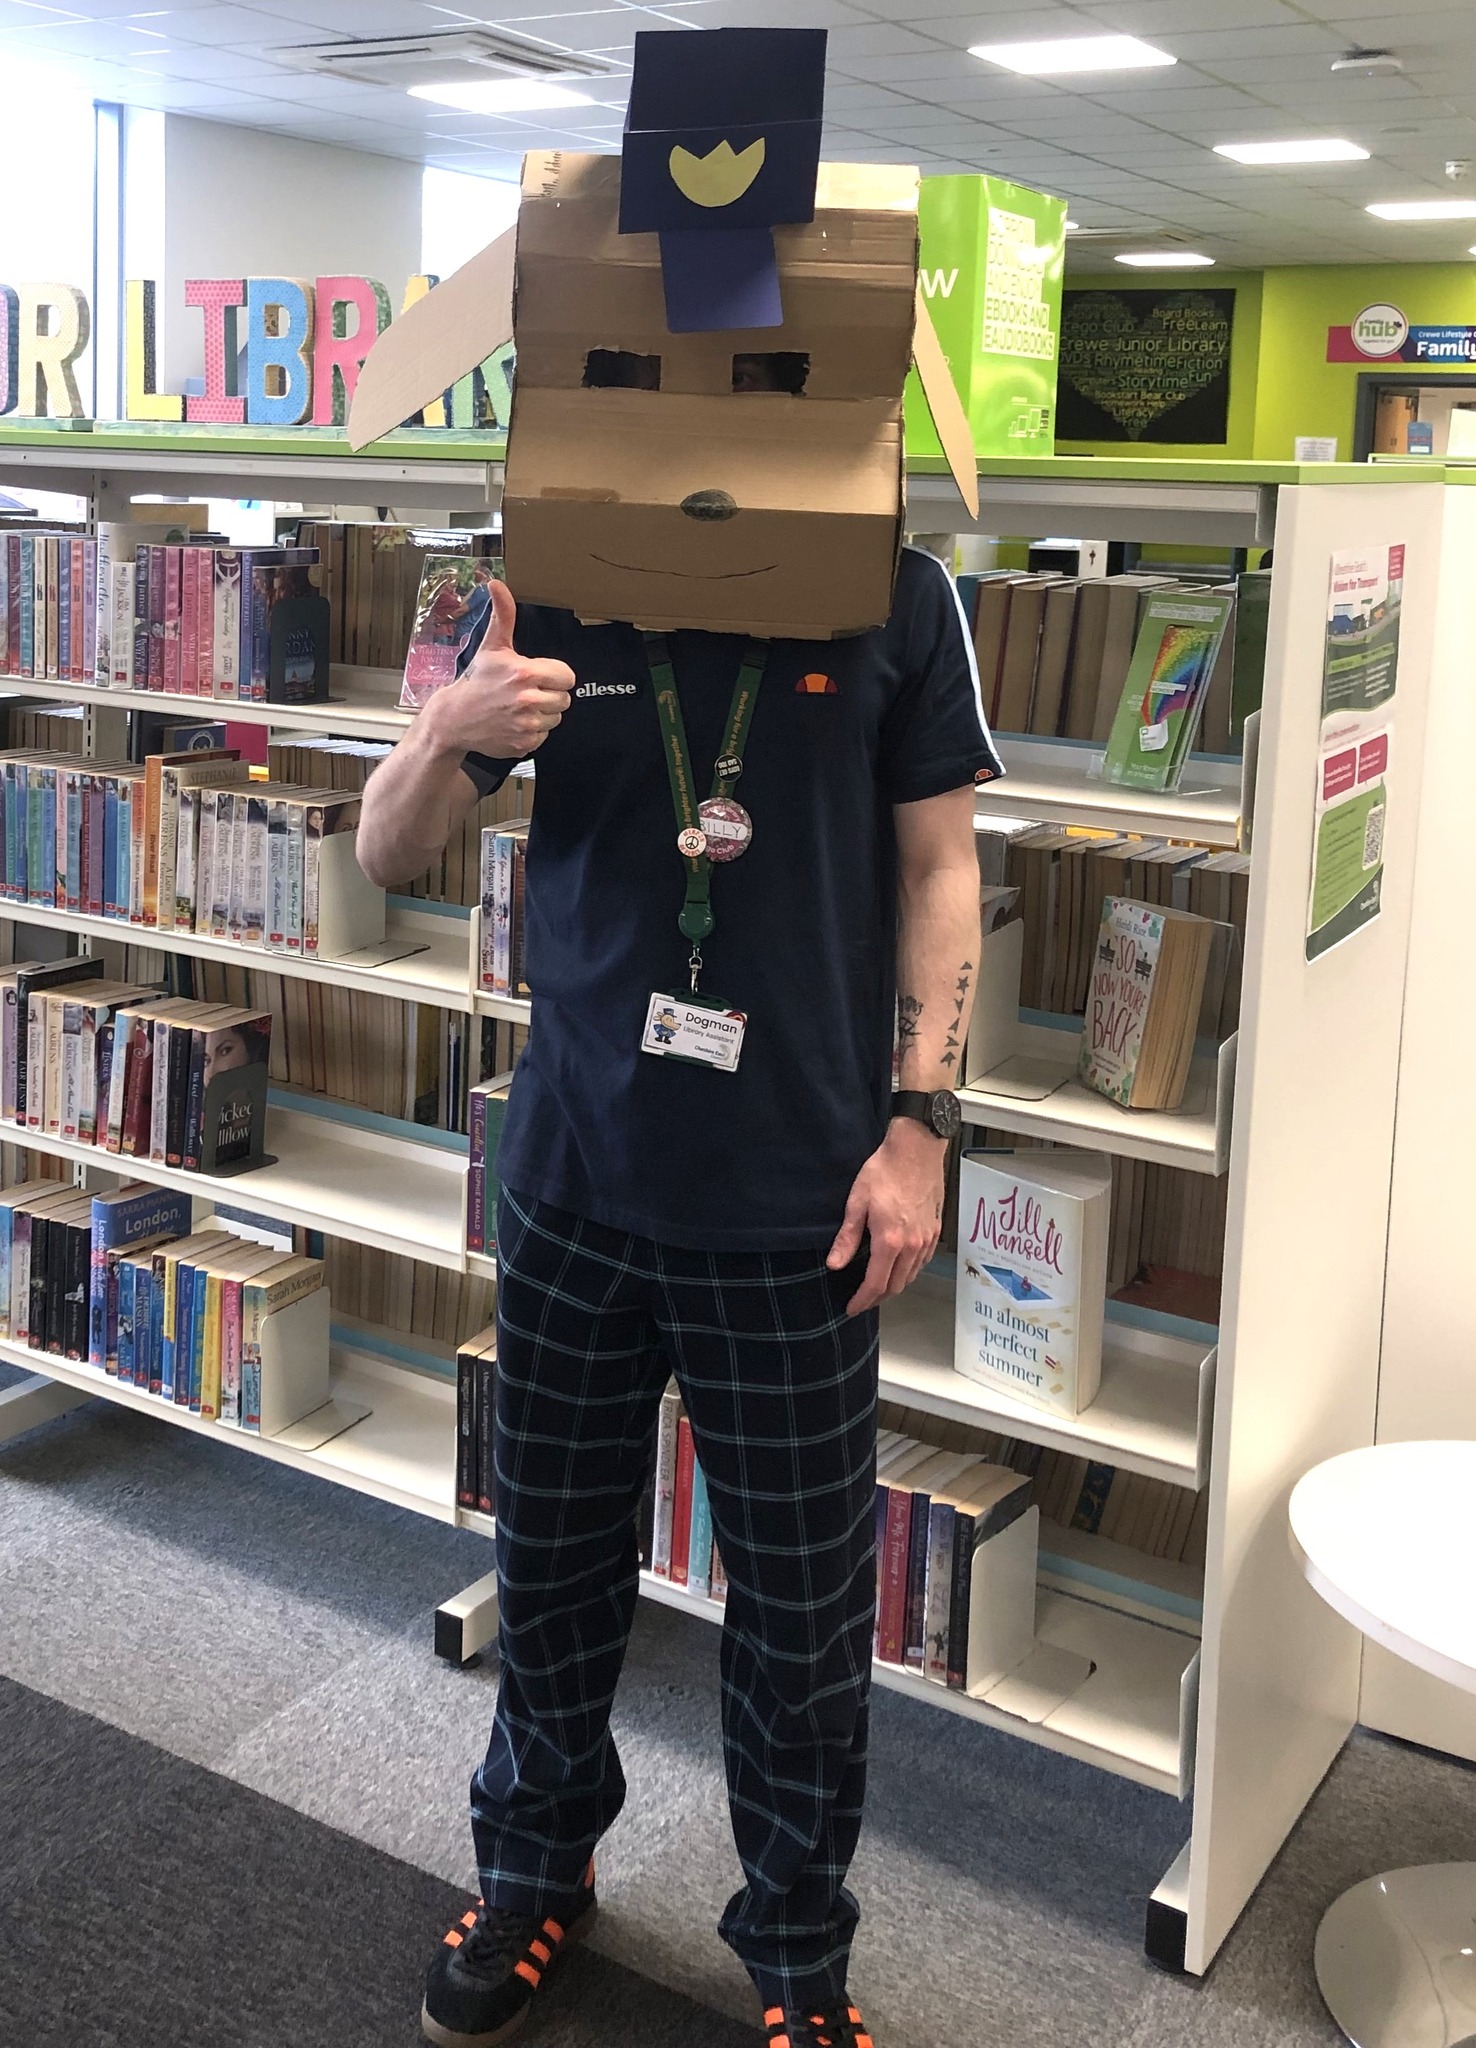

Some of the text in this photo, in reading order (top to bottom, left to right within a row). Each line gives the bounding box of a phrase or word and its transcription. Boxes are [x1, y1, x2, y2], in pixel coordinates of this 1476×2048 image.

[986, 297, 1028, 326] EBOOKS
[1103, 319, 1135, 333] Club
[1152, 308, 1215, 318] Board Books
[1162, 318, 1195, 331] Free
[1195, 319, 1228, 331] Learn
[984, 325, 1054, 357] EAUDIOBOOKS
[1059, 336, 1227, 355] Crewe Junior Library
[1358, 321, 1399, 338] hub
[1441, 330, 1473, 339] Lifestyle
[1095, 352, 1177, 369] Rhymetime
[1176, 356, 1223, 370] Fiction
[1188, 370, 1212, 383] Fun
[1118, 373, 1189, 390] Storytime
[1140, 390, 1163, 400] Bear
[1164, 390, 1186, 401] Club
[1112, 407, 1154, 420] Literacy
[243, 594, 251, 627] JEFFRIES
[575, 682, 638, 698] ellesse
[670, 734, 683, 766] together
[160, 802, 170, 858] LAURENS
[167, 811, 175, 848] STEPHANIE
[200, 825, 209, 861] LAURENS
[217, 823, 227, 858] LAURENS
[232, 824, 241, 859] LAURENS
[249, 826, 259, 860] LAURENS
[700, 820, 742, 839] BILLY
[149, 833, 157, 875] River Road
[270, 836, 281, 873] LAURENS
[287, 838, 297, 876] LAURENS
[305, 841, 315, 877] LAURENS
[158, 862, 167, 906] EXPECTATIONS
[165, 867, 174, 875] A
[165, 875, 174, 893] LADY
[486, 860, 496, 892] Morgan
[1132, 922, 1147, 937] Rice
[481, 949, 490, 971] Snow
[1115, 935, 1136, 974] SO
[1093, 973, 1119, 998] NOW
[682, 1025, 736, 1045] Library Assistant
[685, 1011, 738, 1035] Dogman
[1092, 999, 1138, 1064] BACK
[29, 1026, 37, 1060] LAURENS
[49, 1025, 58, 1064] LAURENS
[65, 1036, 74, 1070] LAURENS
[18, 1060, 27, 1108] FAIR JUNO
[473, 1099, 485, 1116] He's
[473, 1168, 483, 1230] SOPHIE RANALD
[998, 1186, 1043, 1244] Jill
[125, 1207, 182, 1235] London,
[969, 1196, 1064, 1276] Mansell
[98, 1219, 107, 1260] London
[267, 1272, 323, 1306] Sarah Morgan
[250, 1290, 260, 1342] Sarah Morgan
[974, 1299, 1052, 1344] an almost
[984, 1326, 1039, 1363] perfect
[978, 1348, 1044, 1388] summer
[460, 1375, 471, 1437] Rogue Hunter
[660, 1399, 673, 1481] ERICA SPINDLER
[890, 1499, 907, 1576] You Me Forever
